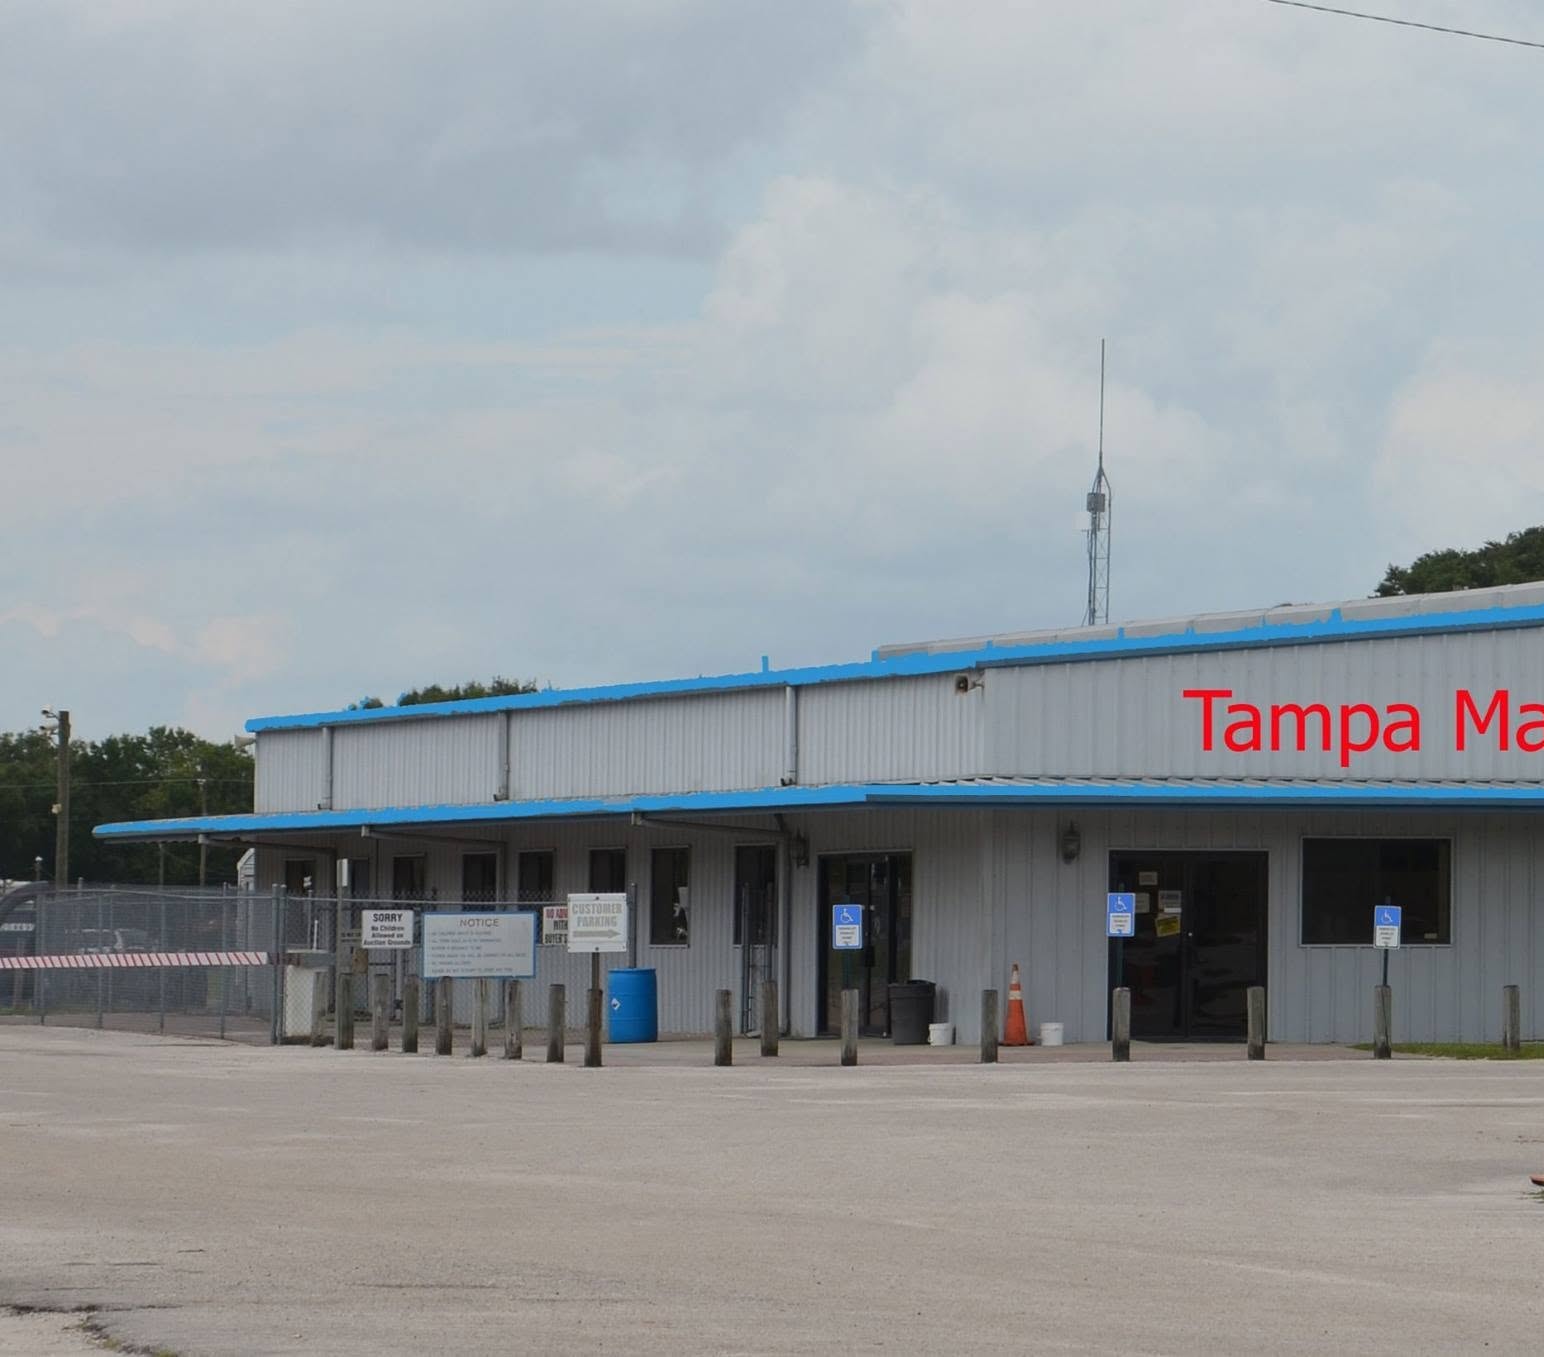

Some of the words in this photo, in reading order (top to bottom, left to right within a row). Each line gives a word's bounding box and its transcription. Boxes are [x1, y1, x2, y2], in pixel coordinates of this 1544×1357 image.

[572, 903, 622, 914] CUSTOMER
[372, 912, 403, 922] SORRY
[576, 915, 617, 927] PARKING
[459, 918, 500, 928] NOTICE
